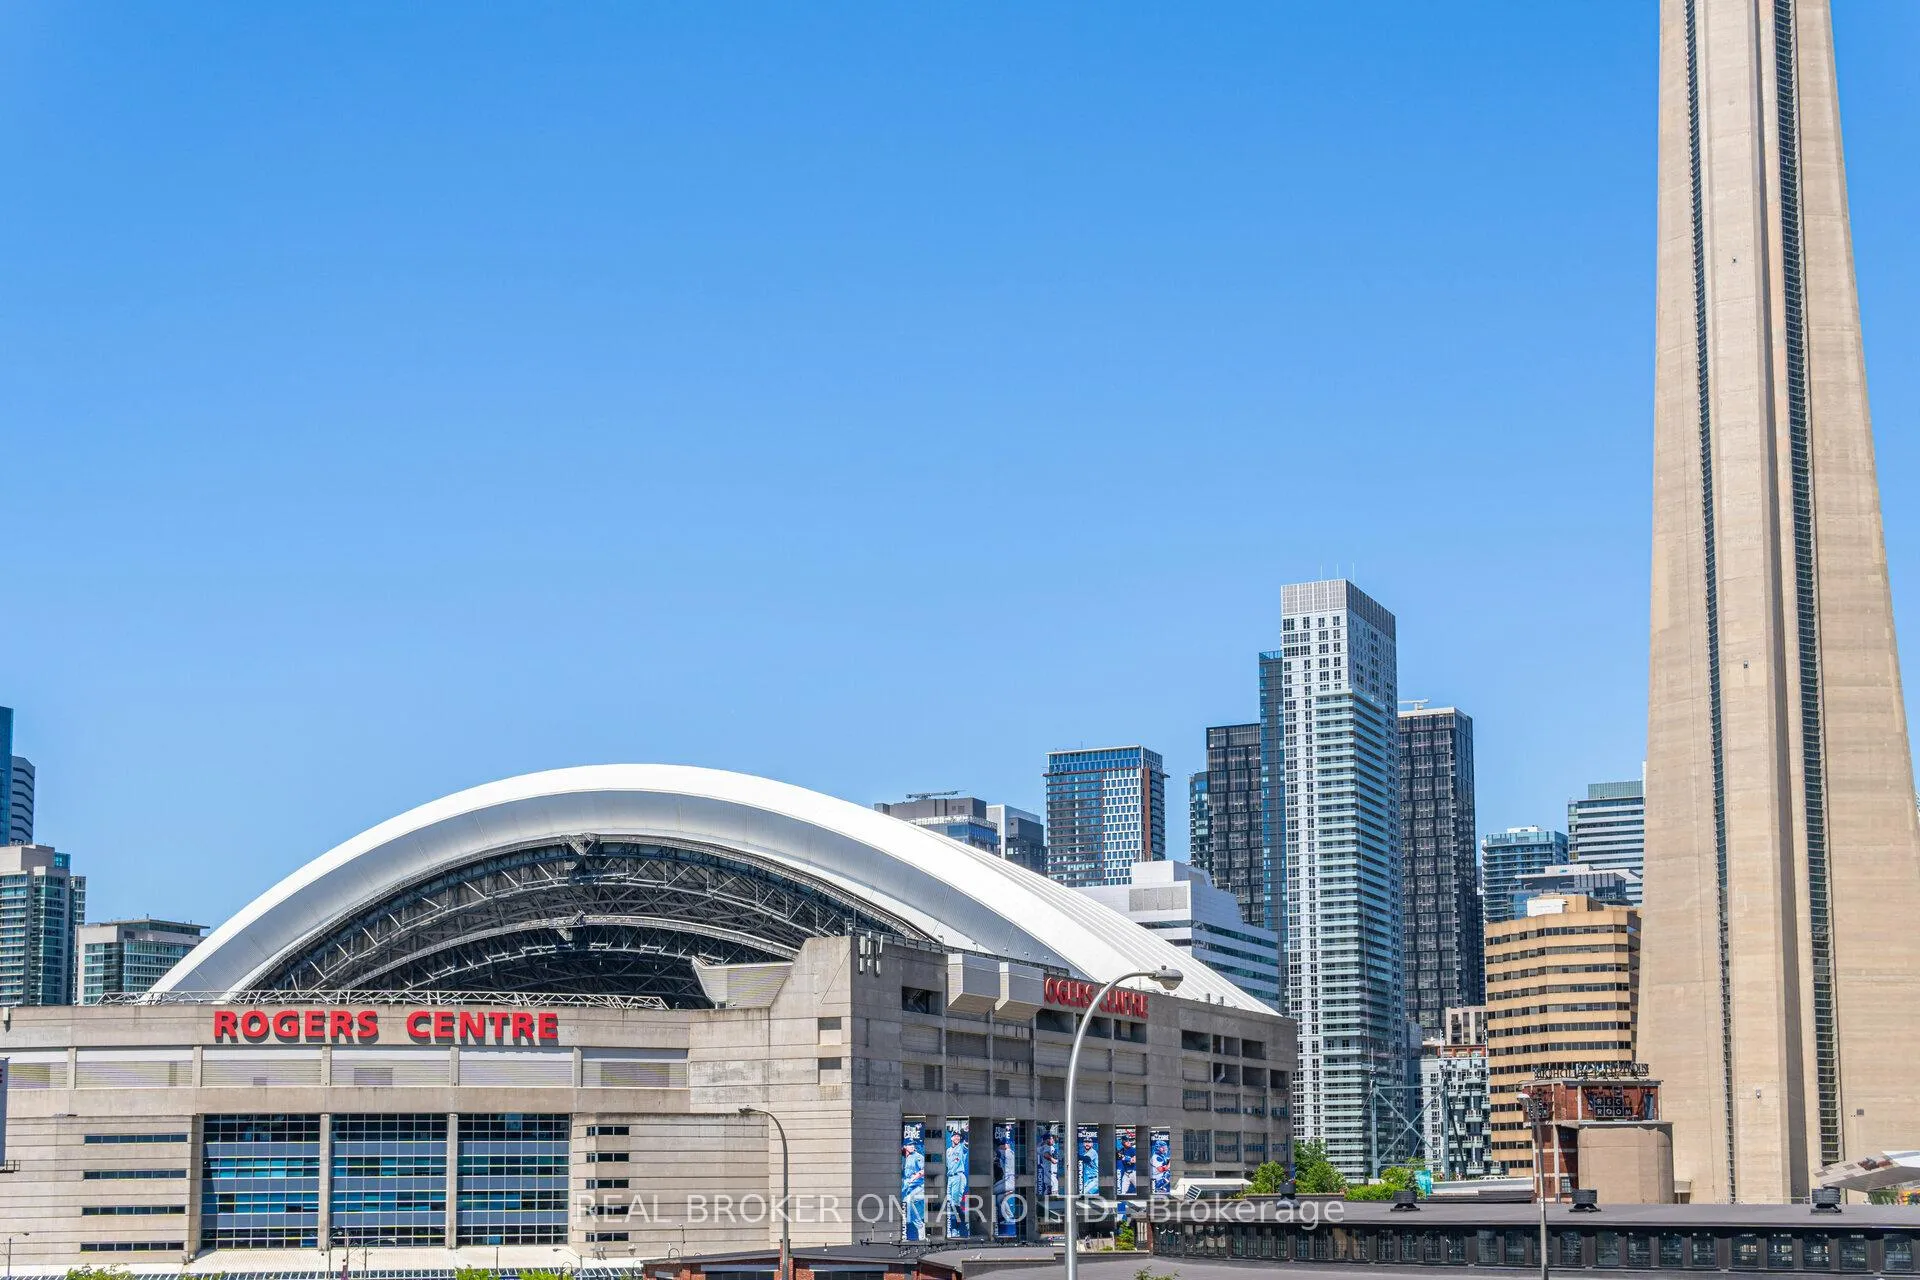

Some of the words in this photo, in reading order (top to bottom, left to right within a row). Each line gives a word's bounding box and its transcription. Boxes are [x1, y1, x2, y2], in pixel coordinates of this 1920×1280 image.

[1044, 976, 1095, 1008] OGERS
[1099, 987, 1149, 1020] CENTRE
[214, 1010, 378, 1039] ROGERS
[406, 1010, 559, 1040] CENTRE
